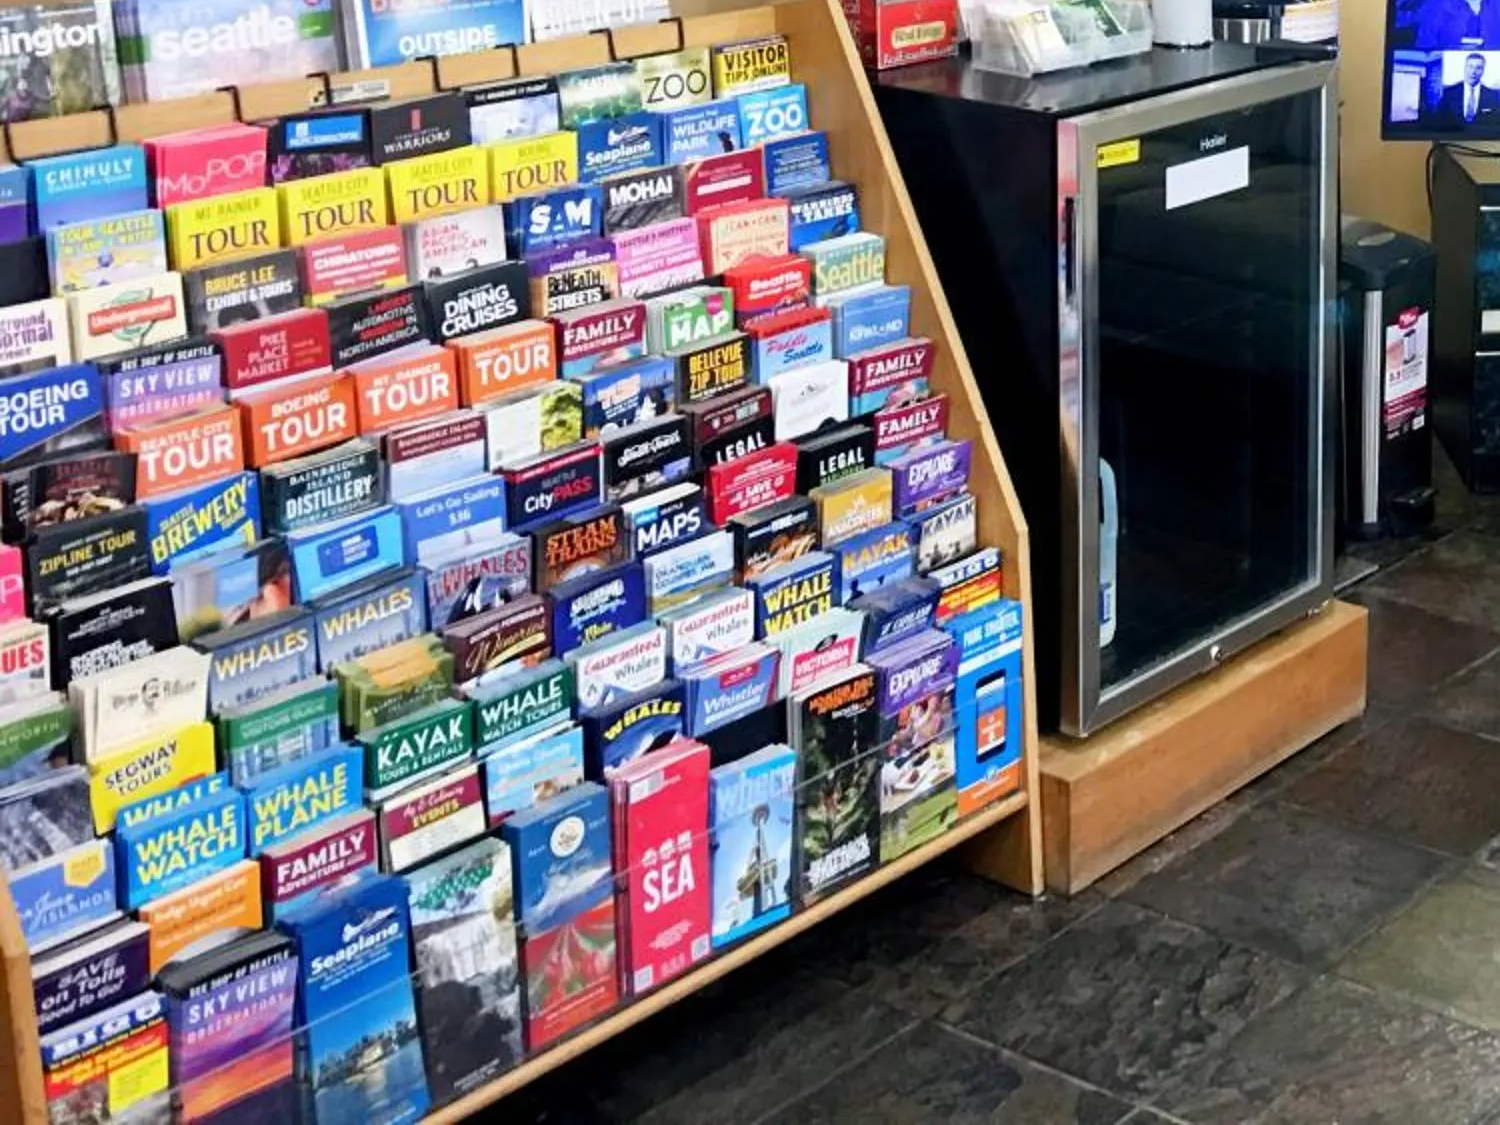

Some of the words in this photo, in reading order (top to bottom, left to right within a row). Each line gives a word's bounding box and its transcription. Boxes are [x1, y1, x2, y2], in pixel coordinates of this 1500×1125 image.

[157, 4, 295, 59] seattle
[398, 24, 496, 56] OUTSIDE
[723, 45, 786, 70] VISITOR
[643, 69, 707, 103] ZOO
[673, 114, 737, 138] WILDLIFE
[746, 103, 802, 134] ZOO
[384, 129, 451, 154] WARRIORS
[586, 140, 651, 166] Seaplane
[672, 134, 710, 152] PARK
[46, 157, 134, 184] CHIHULY
[501, 159, 568, 194] TOUR
[407, 178, 478, 215] TOUR
[610, 176, 674, 206] MOHAI
[300, 198, 376, 237] TOUR
[189, 219, 269, 259] TOUR
[205, 272, 247, 295] BRUCE
[252, 264, 276, 284] LEE
[817, 249, 884, 292] Seattle
[441, 299, 518, 337] CRUISES
[445, 284, 510, 319] DINING
[549, 288, 602, 312] STREETS
[259, 331, 287, 347] PIKE
[563, 315, 636, 346] FAMILY
[671, 310, 729, 346] MAP
[238, 359, 289, 380] MARKET
[248, 345, 288, 365] PLACE
[475, 343, 550, 385] TOUR
[689, 341, 744, 374] BELLEVUE
[866, 350, 926, 376] FAMILY
[0, 379, 89, 415] BOEING
[120, 373, 158, 398] SKY
[164, 363, 213, 388] VIEW
[364, 374, 450, 416] TOUR
[690, 371, 710, 393] ZIP
[0, 404, 65, 435] TOUR
[271, 389, 330, 418] BOEING
[879, 406, 941, 435] FAMILY
[140, 428, 201, 449] SEATTLE
[261, 402, 347, 452] TOUR
[140, 434, 234, 481] TOUR
[716, 432, 766, 463] LEGAL
[819, 446, 865, 476] LEGAL
[289, 455, 366, 486] BAINBRIDGE
[306, 471, 352, 491] ISLAND
[908, 450, 956, 487] EXPLORE
[286, 475, 372, 519] DISTILLERY
[416, 501, 442, 519] Let's
[464, 486, 500, 504] Sailing
[524, 476, 593, 513] CityPASS
[152, 476, 247, 564] BREWERY
[548, 515, 615, 548] STEAM
[637, 508, 700, 552] MAPS
[39, 547, 93, 575] ZIPLINE
[100, 531, 136, 554] TOUR
[547, 526, 616, 564] TRAINS
[443, 546, 527, 597] WHALES
[764, 570, 831, 613] WHALE
[323, 588, 413, 641] WHALES
[677, 596, 749, 636] Guaranteed
[764, 595, 831, 635] WATCH
[215, 628, 309, 681] WHALES
[584, 632, 662, 673] Guaranteed
[890, 654, 943, 697] EXPLORE
[481, 675, 563, 727] WHALE
[704, 682, 766, 717] Whistler
[484, 716, 523, 742] WATCH
[526, 700, 563, 724] TOURS
[604, 700, 682, 741] WHALES
[377, 714, 464, 771] KAYAK
[379, 765, 410, 783] TOURS
[422, 739, 464, 767] RENTALS
[105, 739, 178, 789] SEGWAY
[118, 761, 173, 796] TOURS
[124, 777, 223, 827] WHALE
[255, 763, 347, 820] WHALE
[255, 789, 347, 846] PLANE
[413, 798, 460, 828] EVENTS
[136, 805, 236, 861] WHALE
[138, 825, 237, 885] WATCH
[277, 830, 365, 884] FAMILY
[642, 854, 695, 913] SEA
[311, 921, 399, 975] Seaplane
[41, 989, 71, 1011] on
[78, 965, 126, 992] Tolls
[58, 952, 119, 989] SAVE
[78, 993, 95, 1006] To
[188, 990, 230, 1024] SKY
[236, 967, 289, 1001] VIEW
